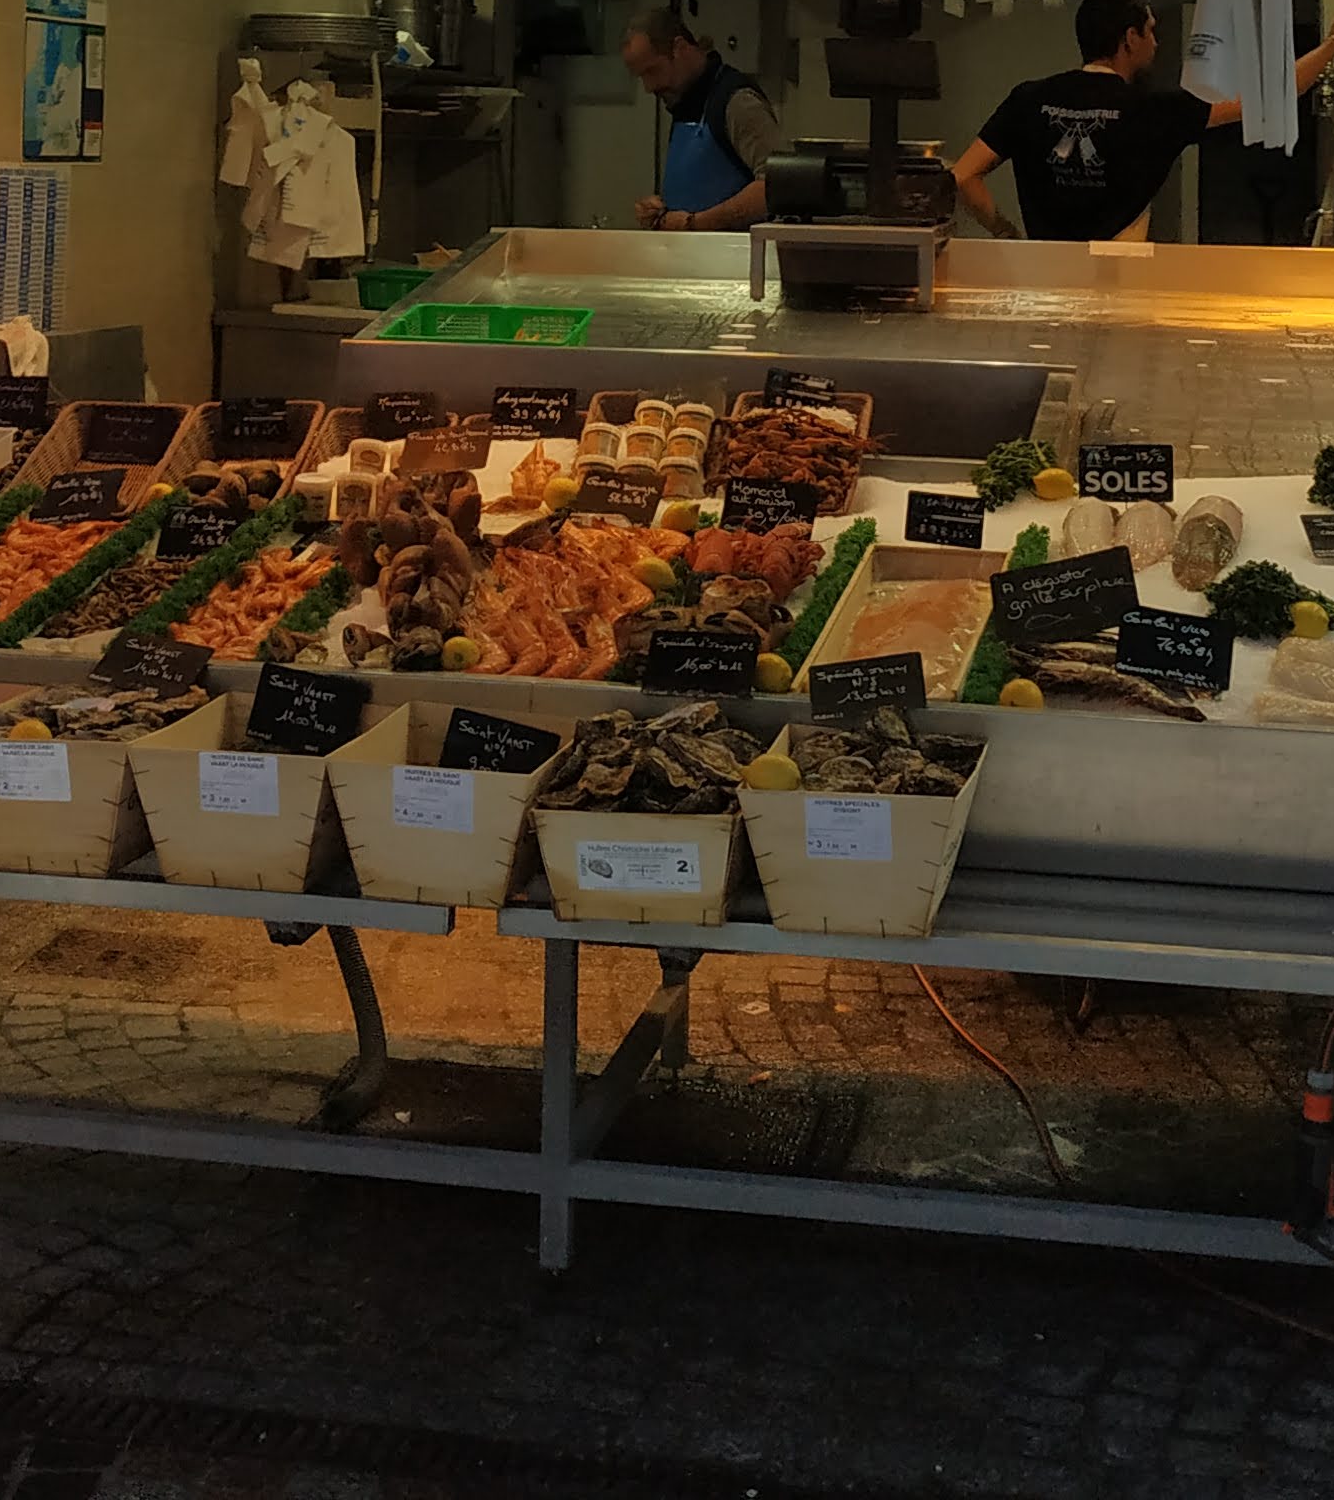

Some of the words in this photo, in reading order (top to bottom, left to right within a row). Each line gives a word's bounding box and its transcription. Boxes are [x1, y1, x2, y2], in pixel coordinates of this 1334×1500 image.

[1084, 470, 1169, 494] SOLES
[458, 719, 497, 740] Saint
[676, 860, 689, 873] 2
